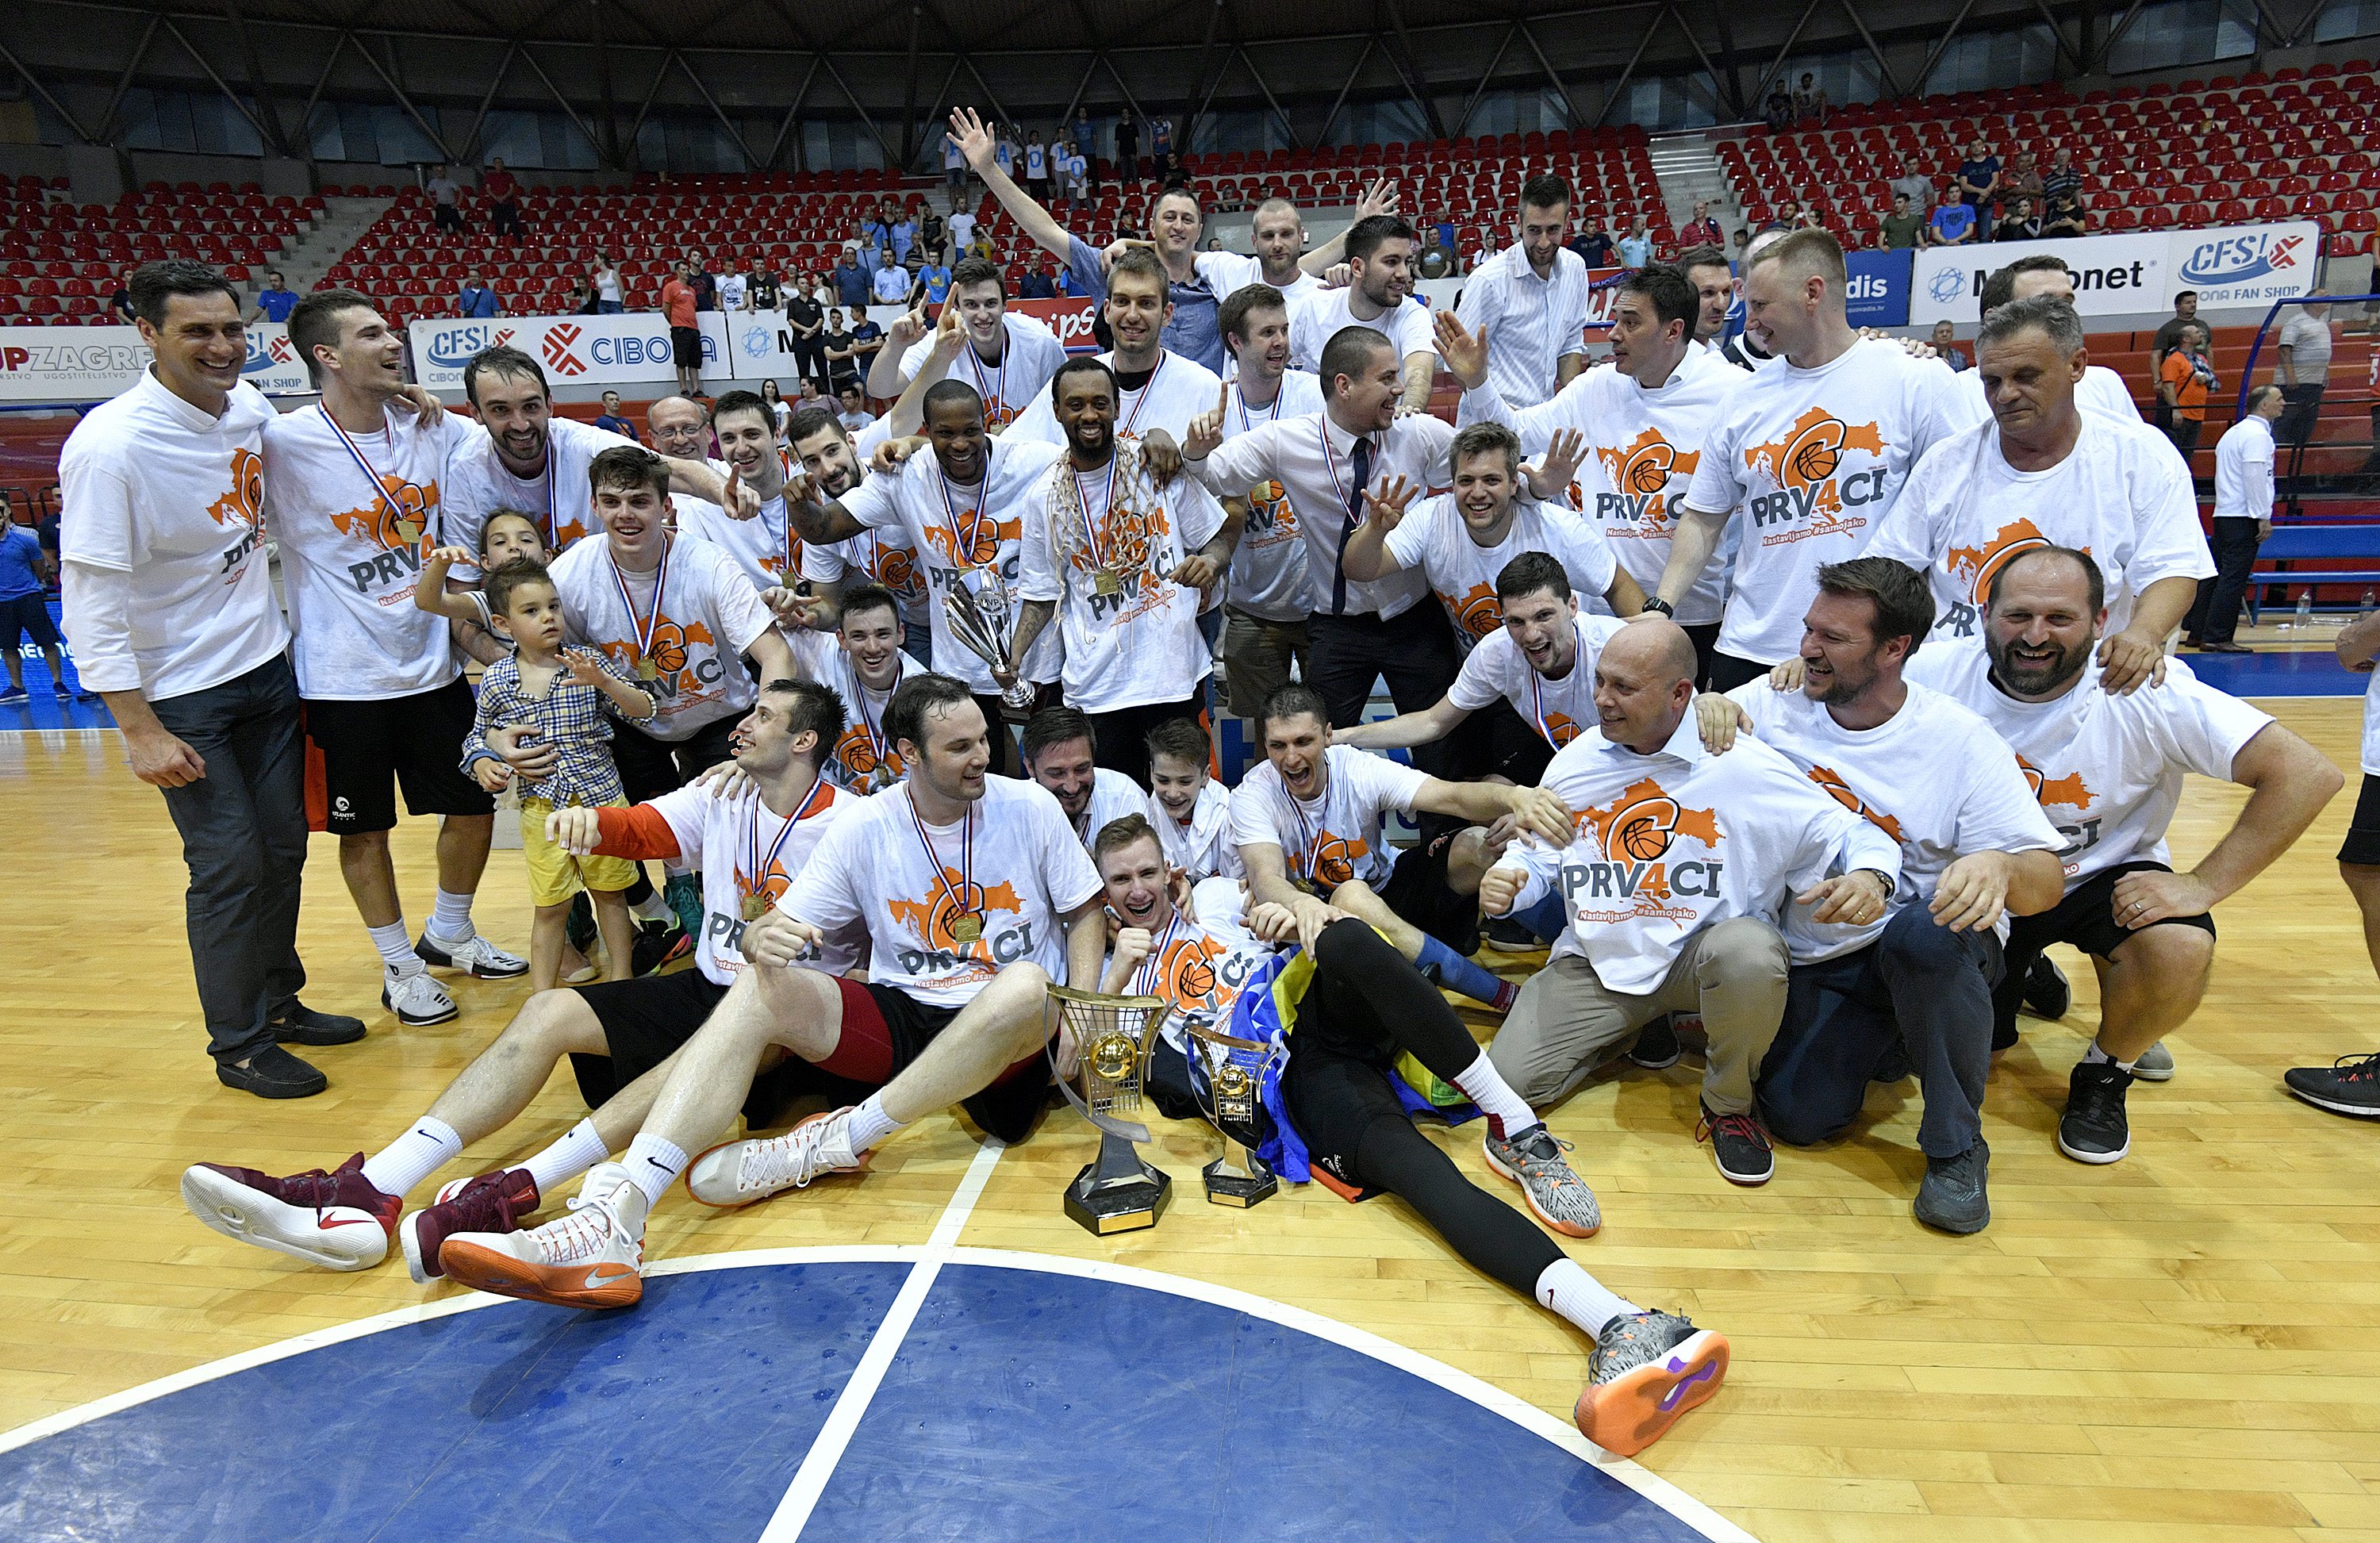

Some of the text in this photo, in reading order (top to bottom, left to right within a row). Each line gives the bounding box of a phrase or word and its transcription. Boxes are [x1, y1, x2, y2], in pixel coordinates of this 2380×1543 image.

[996, 144, 1009, 163] A
[1031, 151, 1042, 168] O
[2191, 232, 2267, 271] CFS!
[1845, 274, 1887, 299] dis
[2234, 288, 2259, 300] FAN
[2264, 286, 2300, 297] SHOP
[591, 335, 718, 365] CIBOA
[44, 371, 128, 380] UGOSTITELJSTVO
[274, 378, 302, 388] SHOP
[1596, 493, 1687, 522] PRV4C
[1762, 517, 1867, 547] Nastavljamo #samojako
[347, 532, 436, 593] PRV4
[1578, 907, 1697, 924] Nastavljamo #samojako
